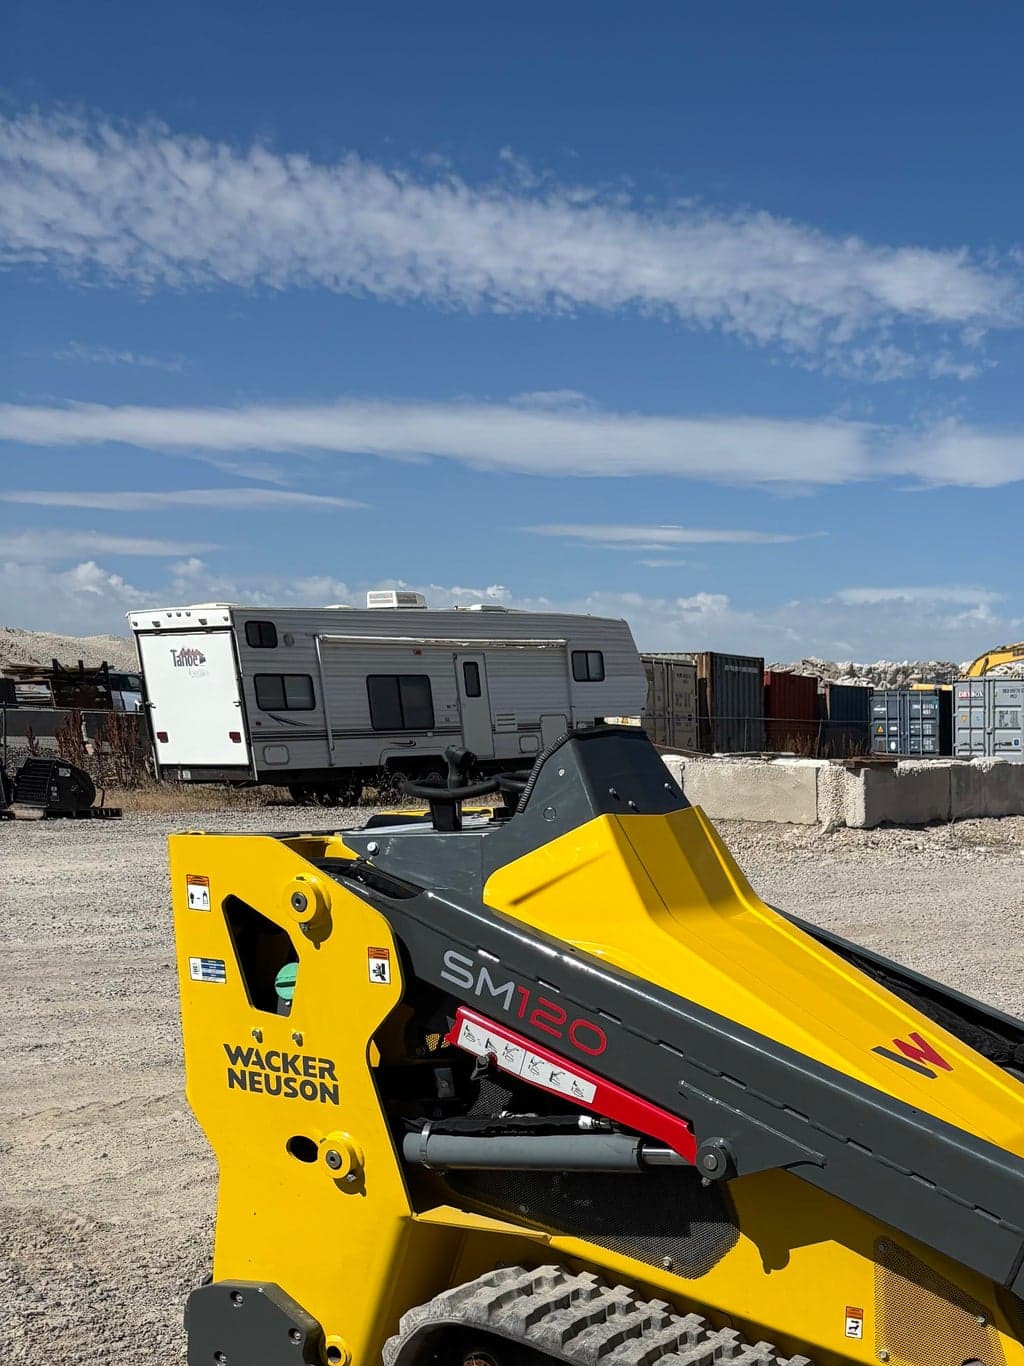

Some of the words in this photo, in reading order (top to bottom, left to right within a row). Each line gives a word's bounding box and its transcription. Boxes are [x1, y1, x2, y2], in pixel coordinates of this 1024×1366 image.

[440, 950, 608, 1057] SM120
[222, 1043, 338, 1082] WACKER
[227, 1067, 340, 1106] NEUSON
